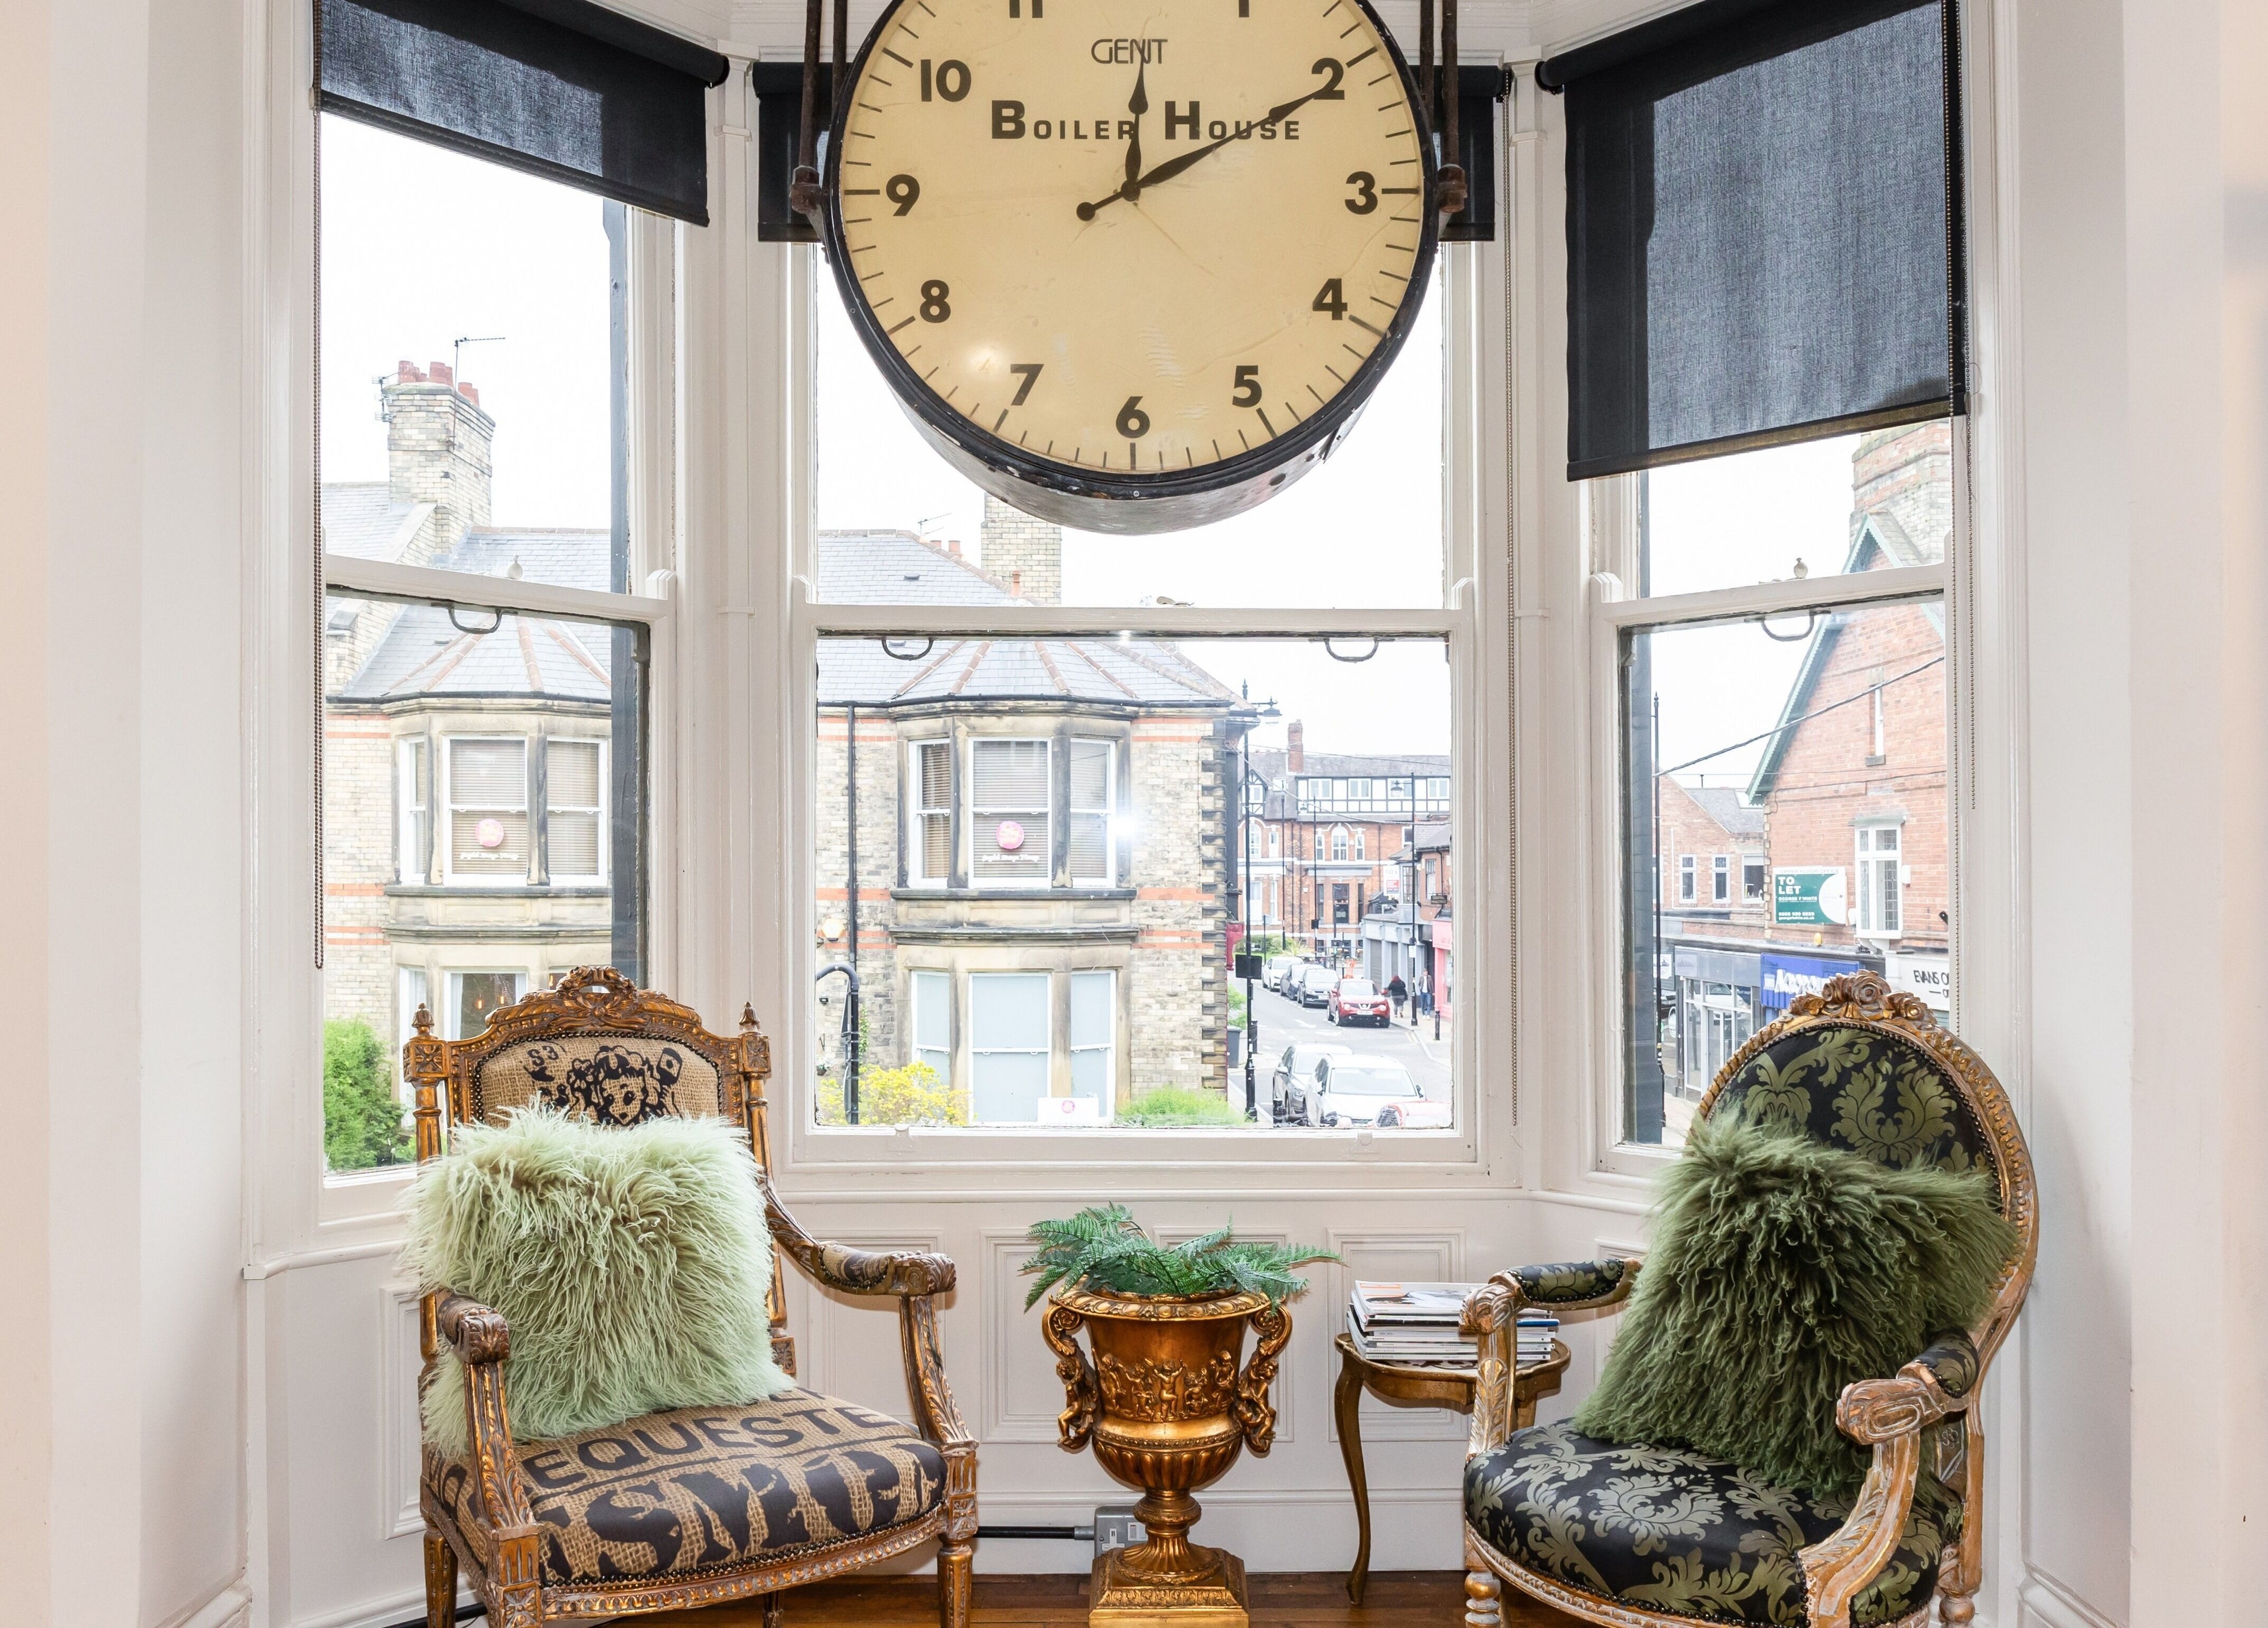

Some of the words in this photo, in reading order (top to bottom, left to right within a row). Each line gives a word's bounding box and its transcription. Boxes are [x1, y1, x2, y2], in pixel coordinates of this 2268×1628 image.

[920, 59, 971, 102] 10
[1311, 57, 1345, 100] 2
[991, 100, 1137, 139] BOILER
[1165, 100, 1299, 140] HOUSE
[885, 174, 920, 217] 9
[1344, 171, 1378, 215] 3
[919, 279, 951, 323] 8
[1312, 278, 1348, 321] 4
[1010, 363, 1044, 406] 7
[1231, 365, 1263, 408] 5
[1115, 396, 1151, 438] 6
[1778, 877, 1795, 885] TO
[1778, 885, 1801, 894] LET
[1913, 970, 1940, 985] EVANS
